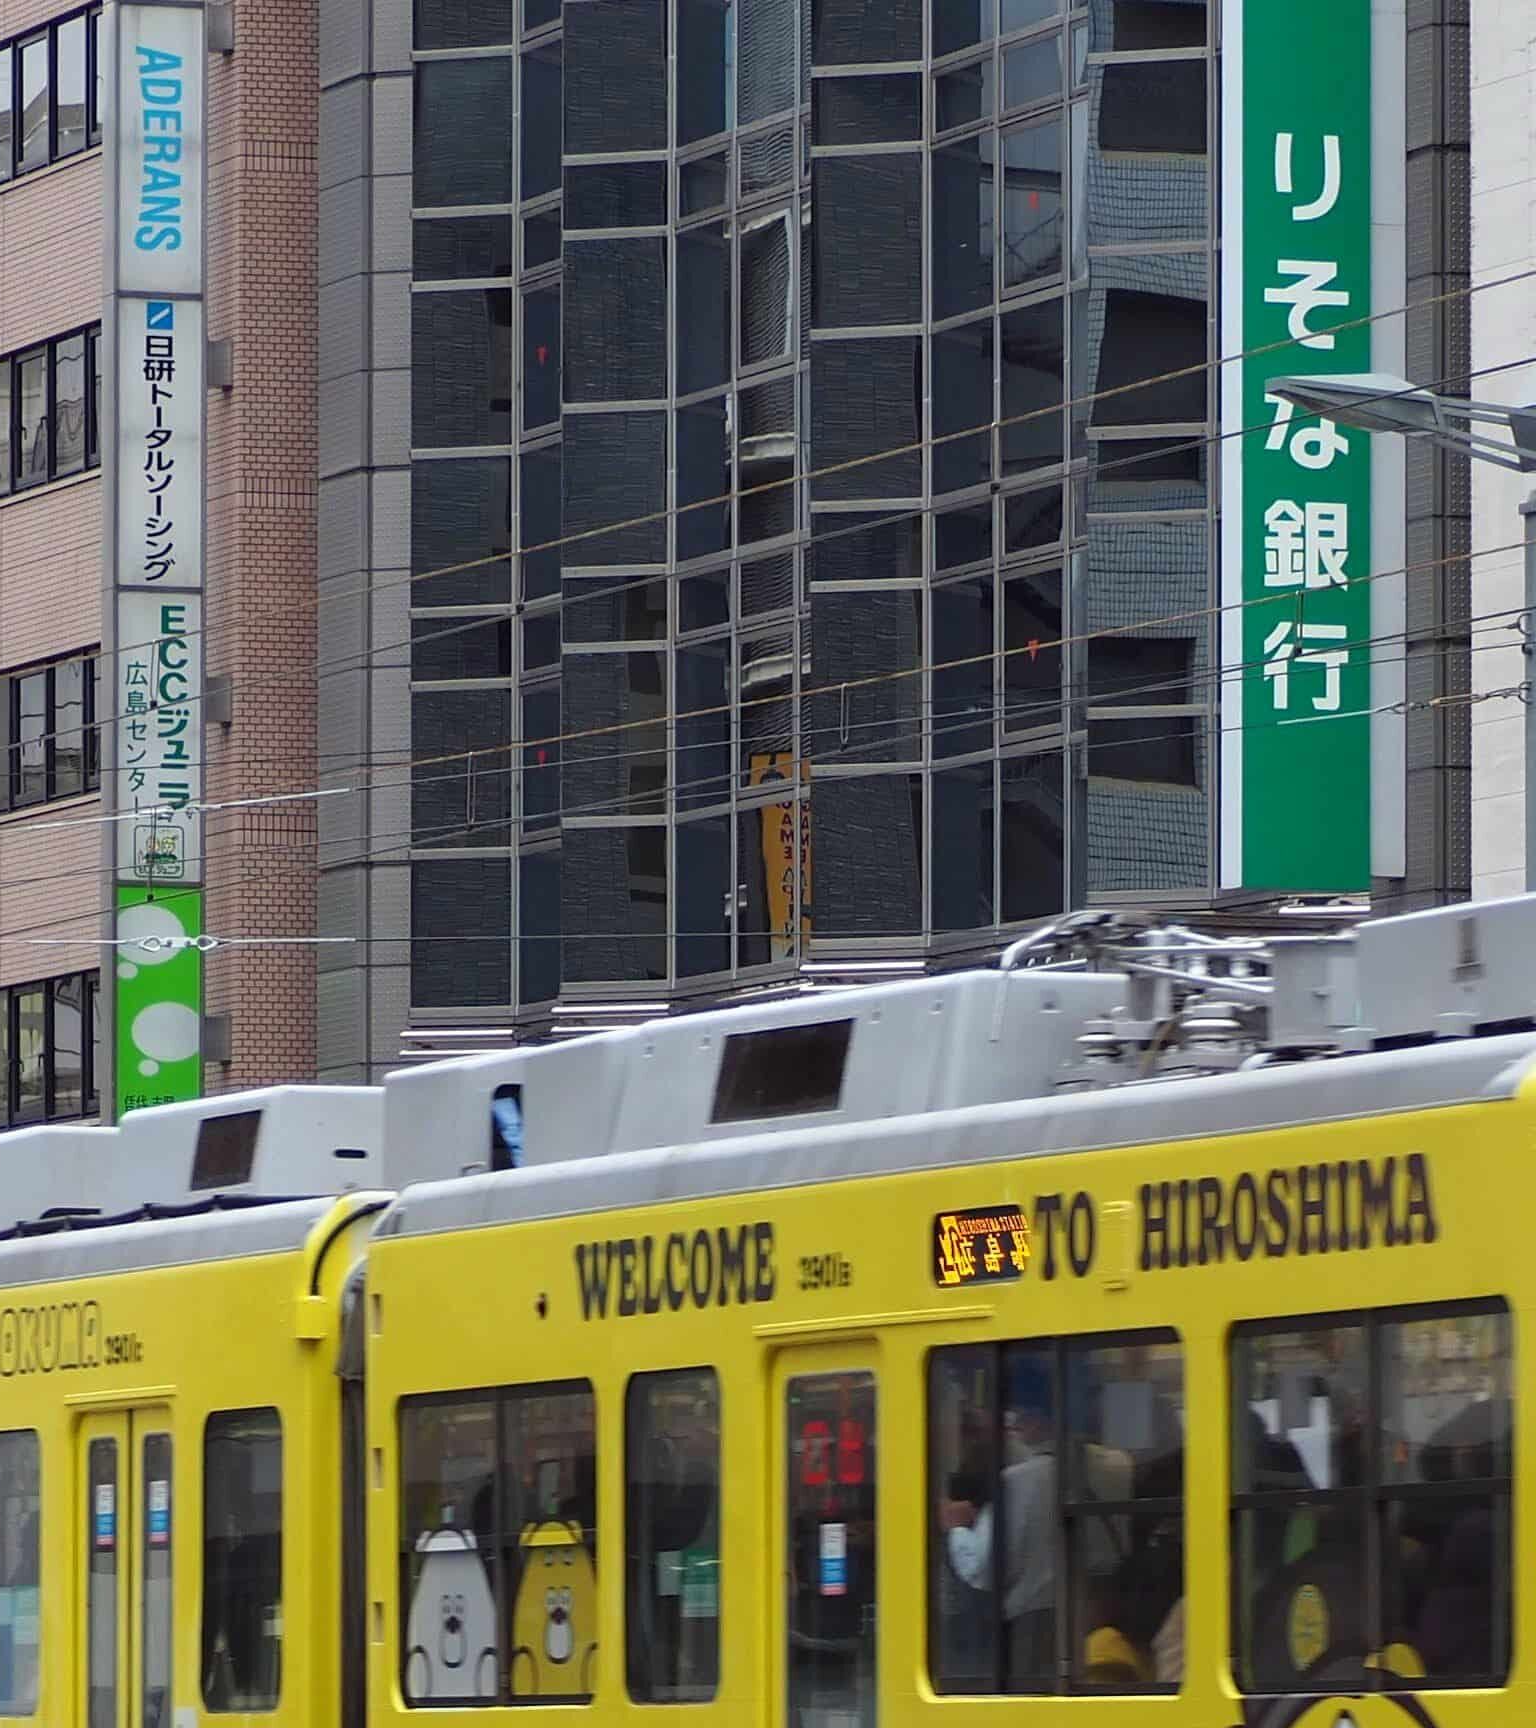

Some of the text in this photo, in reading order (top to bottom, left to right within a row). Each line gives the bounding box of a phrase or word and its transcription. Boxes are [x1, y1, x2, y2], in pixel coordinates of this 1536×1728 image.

[134, 46, 183, 252] ADERANS
[143, 335, 176, 582] 日研トータルソーシング
[125, 660, 149, 821] 広島センター
[574, 1152, 1438, 1322] WELCOME TO HIROSHIMA
